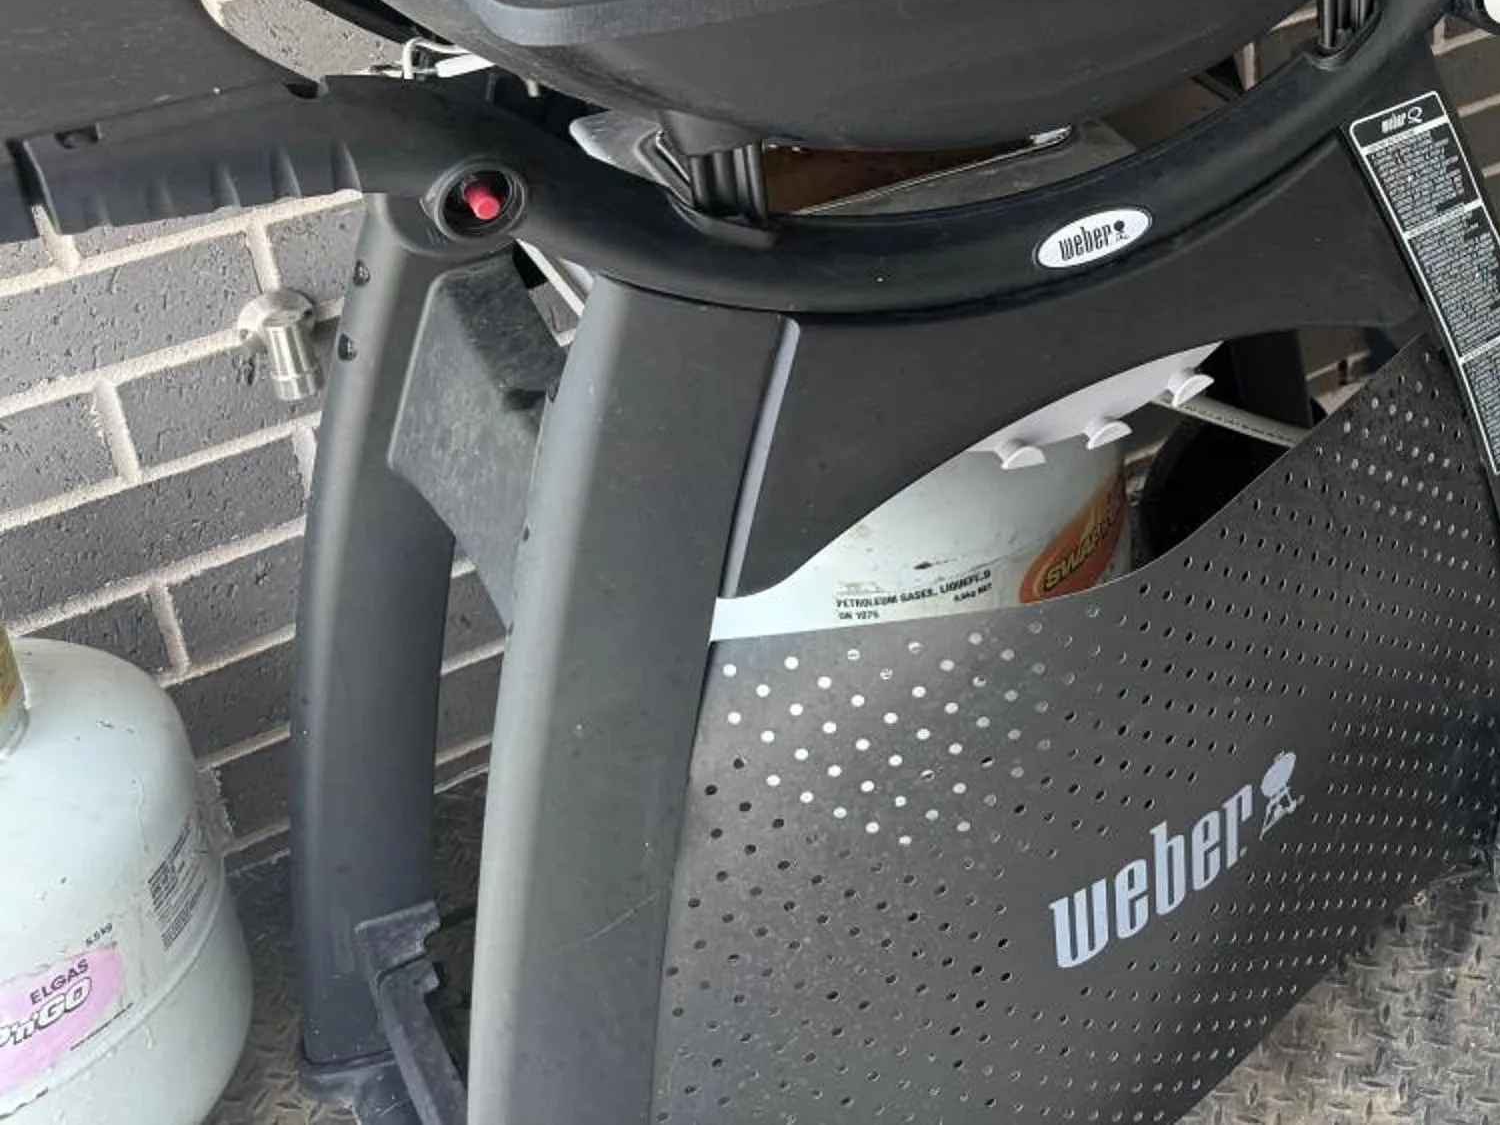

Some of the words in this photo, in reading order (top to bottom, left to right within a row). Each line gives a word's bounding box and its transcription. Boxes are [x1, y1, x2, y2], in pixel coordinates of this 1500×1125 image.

[1058, 222, 1112, 262] weber
[836, 594, 898, 608] PETROLEUM
[1048, 782, 1254, 969] weber
[29, 958, 89, 1006] ELGAS
